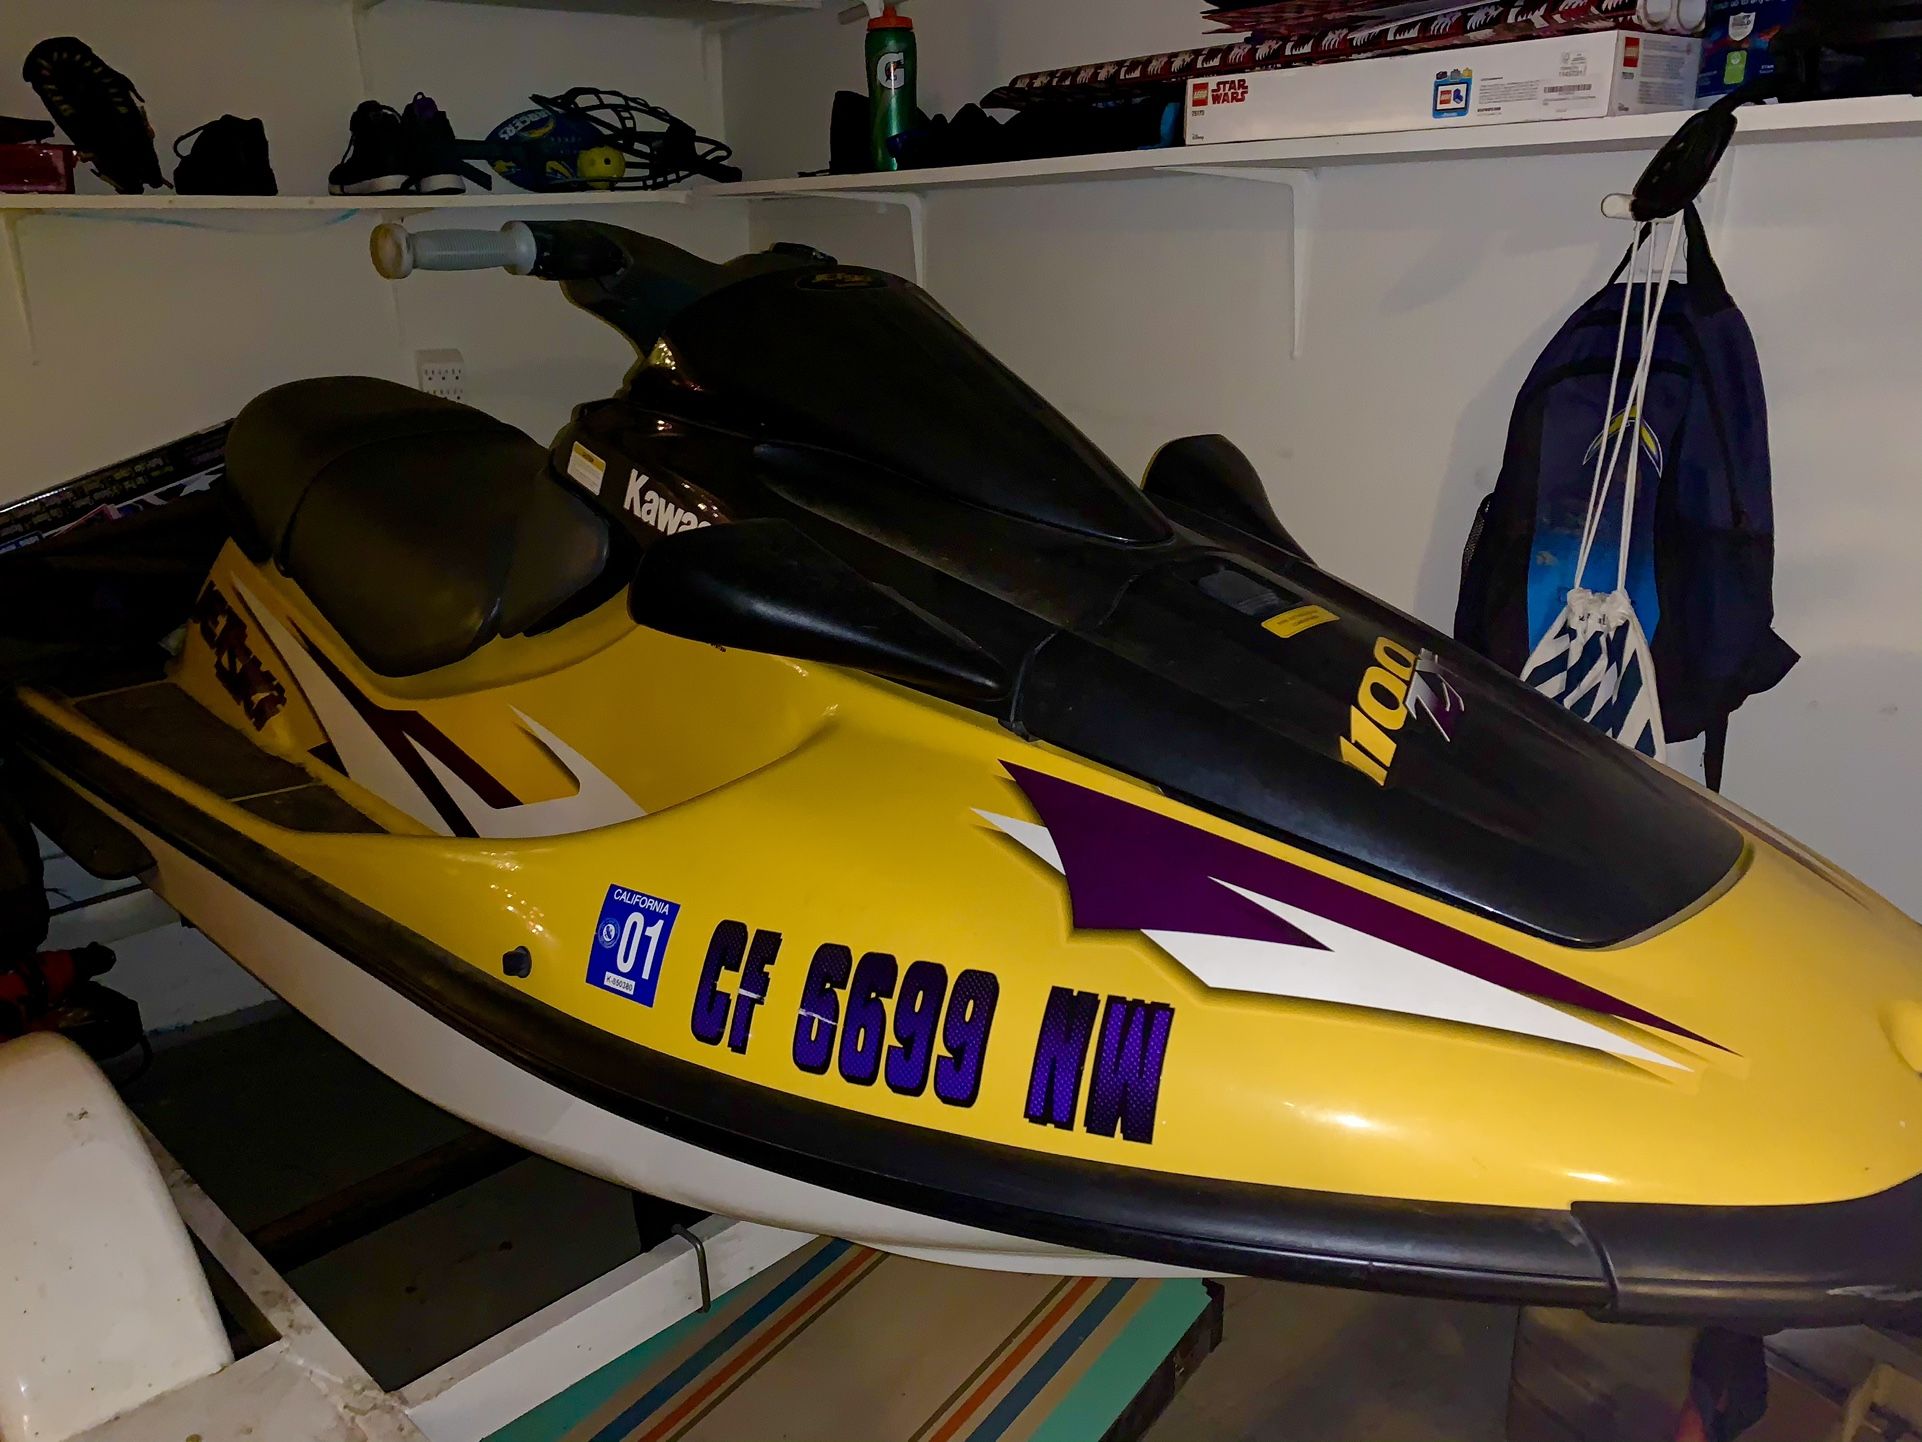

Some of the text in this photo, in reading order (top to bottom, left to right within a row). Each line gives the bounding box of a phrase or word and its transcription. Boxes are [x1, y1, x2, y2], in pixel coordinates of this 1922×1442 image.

[877, 52, 904, 89] G
[1211, 79, 1248, 93] STAR
[1211, 91, 1248, 105] WARS
[623, 468, 711, 536] Kawa
[1339, 636, 1419, 786] 1100
[613, 888, 669, 916] CALIFORNIA
[616, 911, 664, 980] 01
[690, 919, 782, 1055] CF
[792, 943, 1000, 1108] 6699
